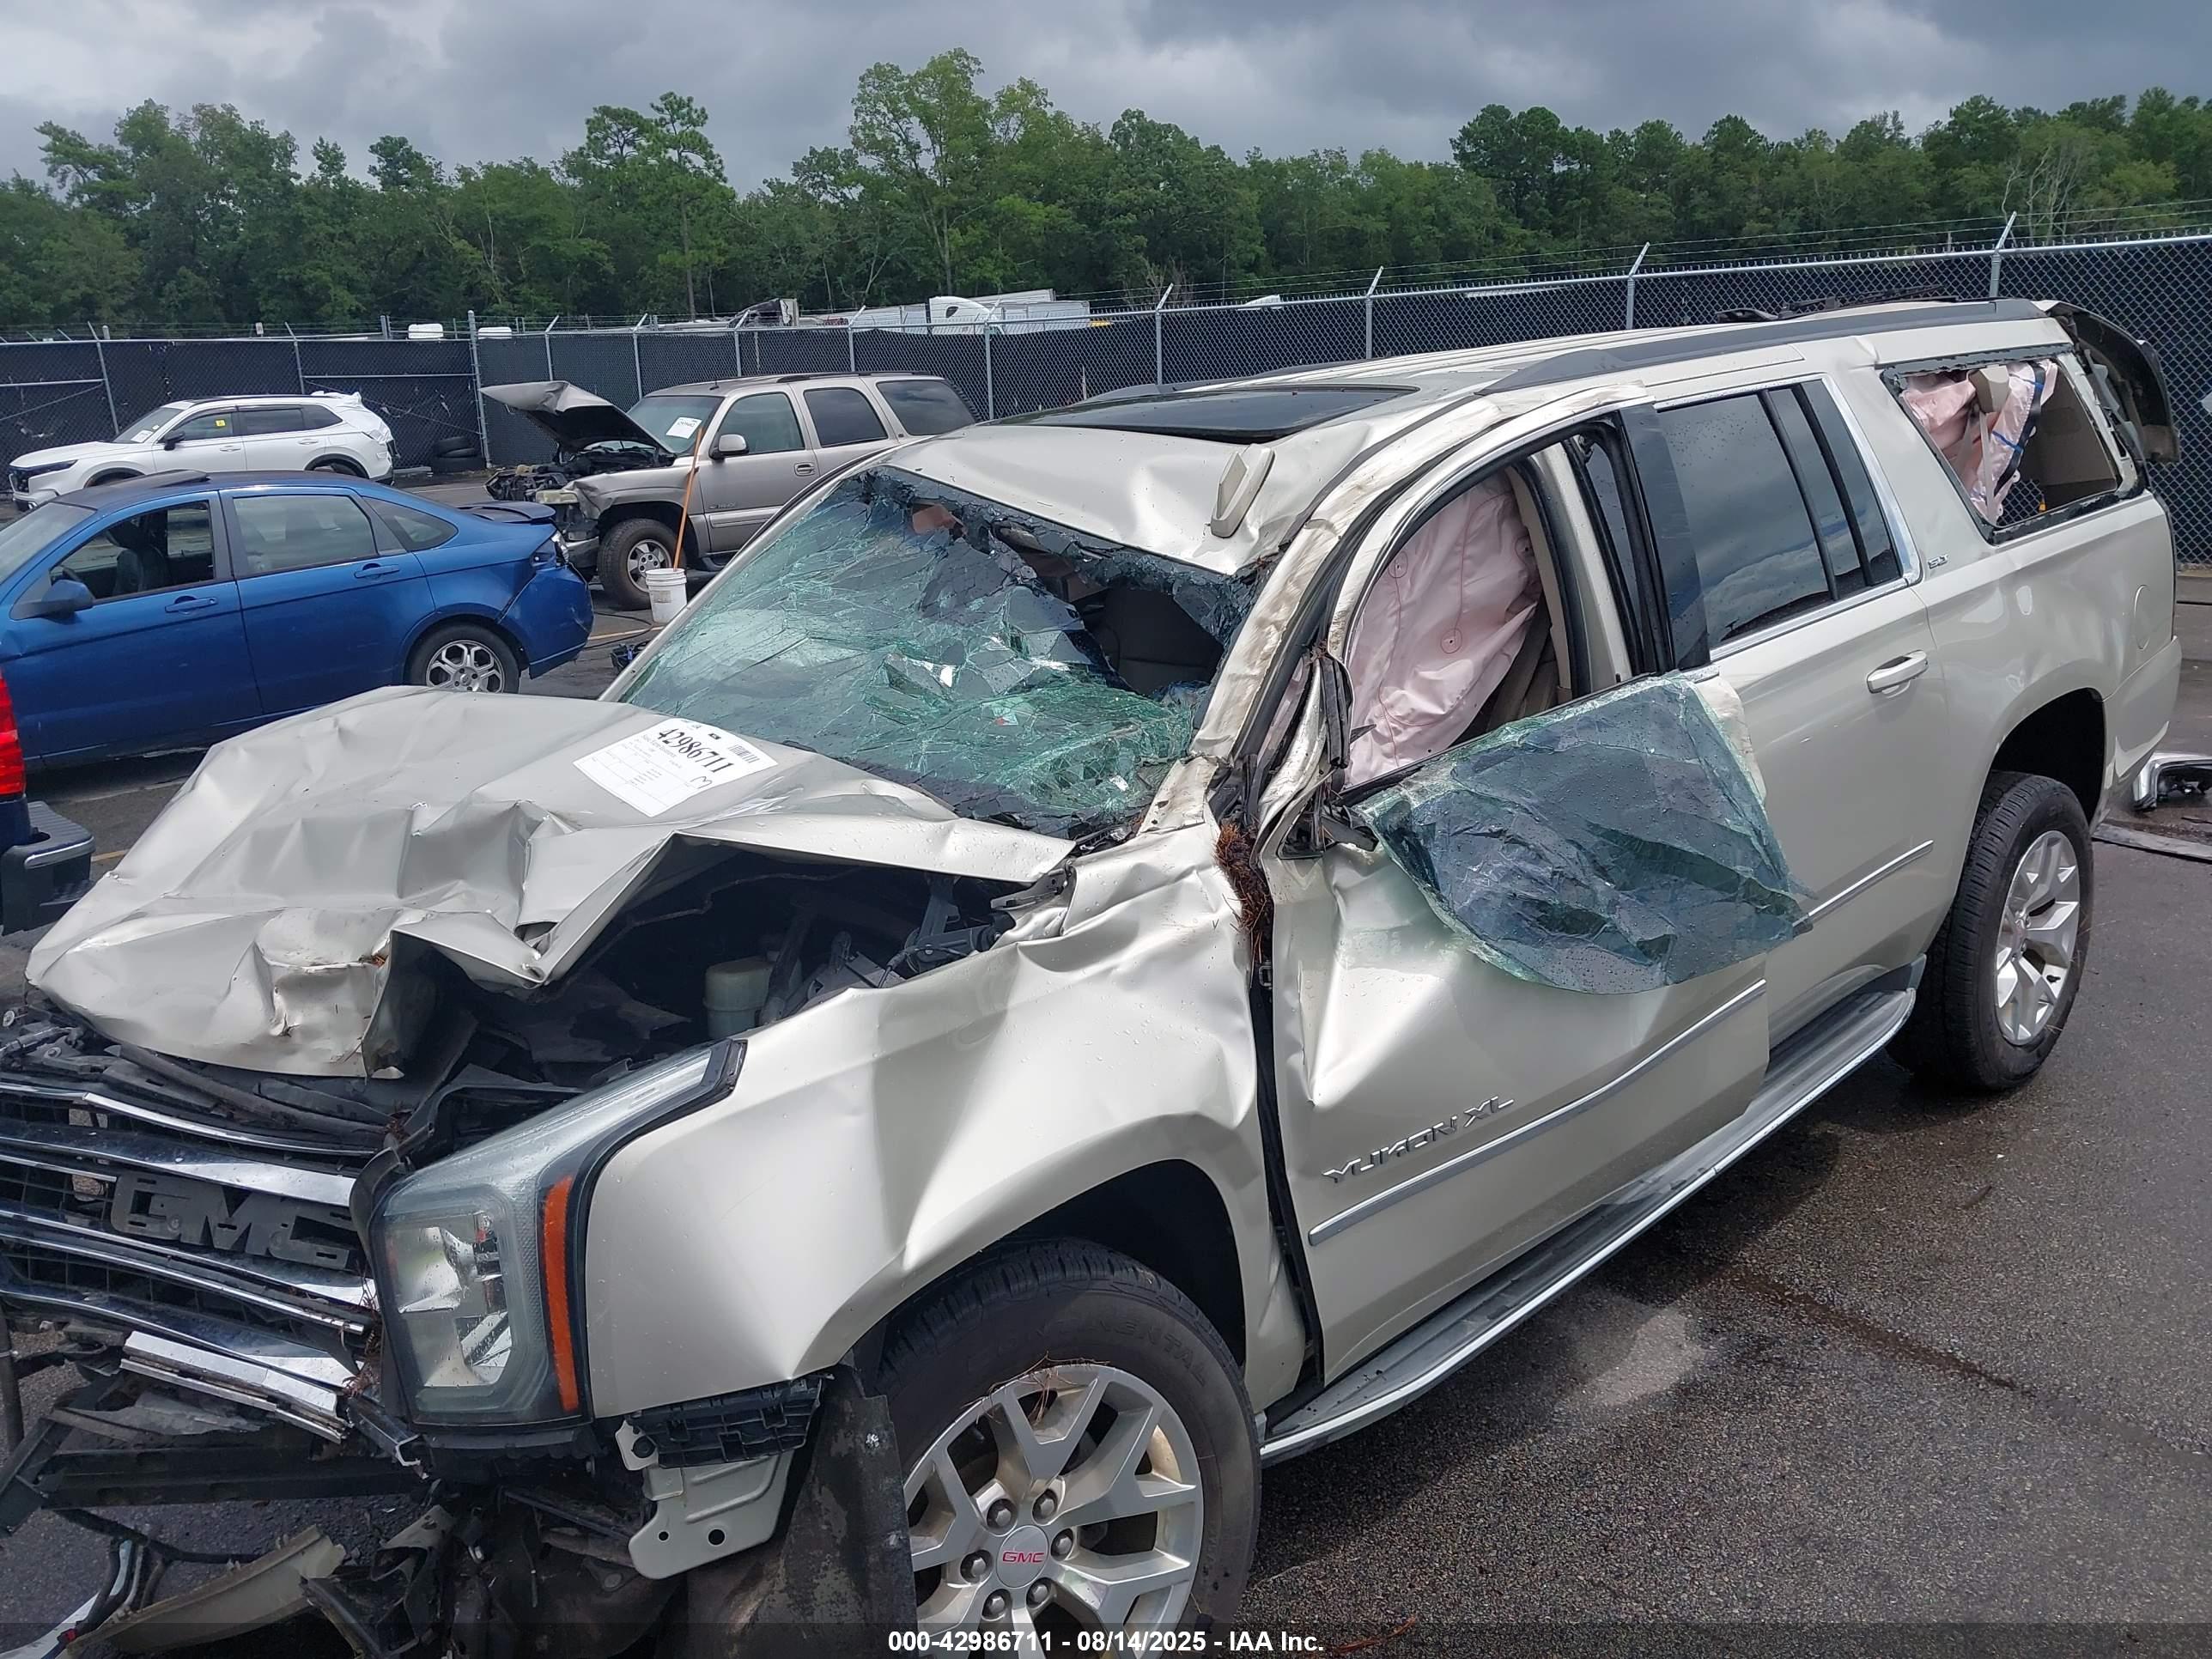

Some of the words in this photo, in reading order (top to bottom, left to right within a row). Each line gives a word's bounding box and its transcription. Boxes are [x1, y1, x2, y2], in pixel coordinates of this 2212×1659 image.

[657, 727, 735, 774] 42986711
[1322, 1115, 1458, 1184] YUKON
[1463, 1096, 1515, 1127] XL
[110, 1170, 359, 1271] GMC
[1002, 1551, 1045, 1563] GMC
